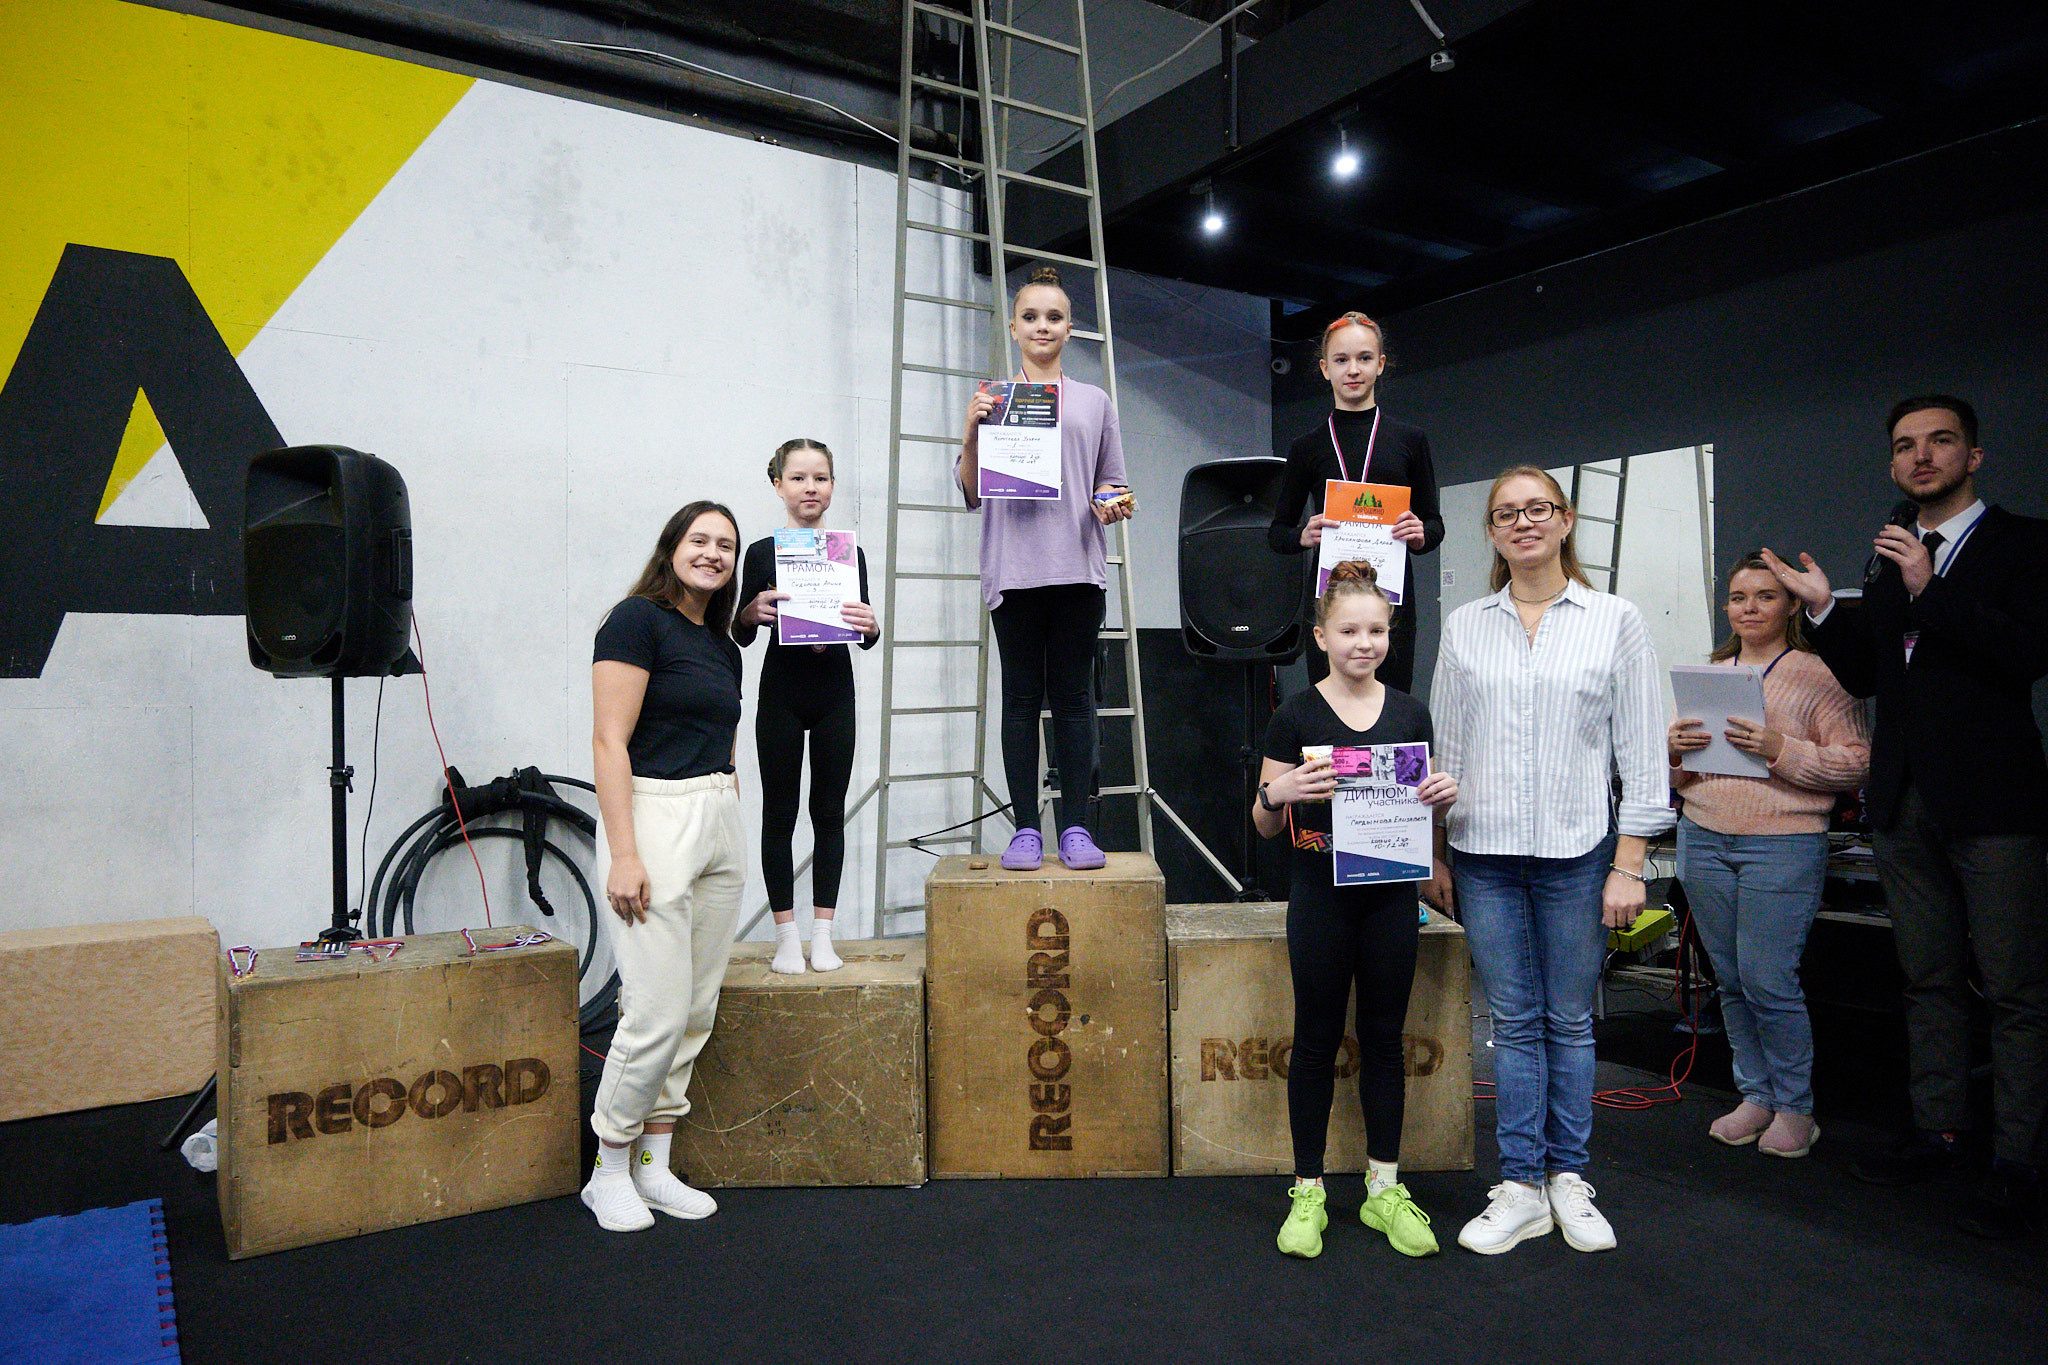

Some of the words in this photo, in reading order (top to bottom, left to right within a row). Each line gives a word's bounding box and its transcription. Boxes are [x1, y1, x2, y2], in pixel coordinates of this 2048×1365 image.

[786, 562, 835, 573] ГРАМОТА
[1344, 786, 1408, 803] ДИПЛОМ
[1367, 796, 1419, 808] участника
[1026, 907, 1073, 1151] RECORD
[267, 1057, 551, 1145] RECORD
